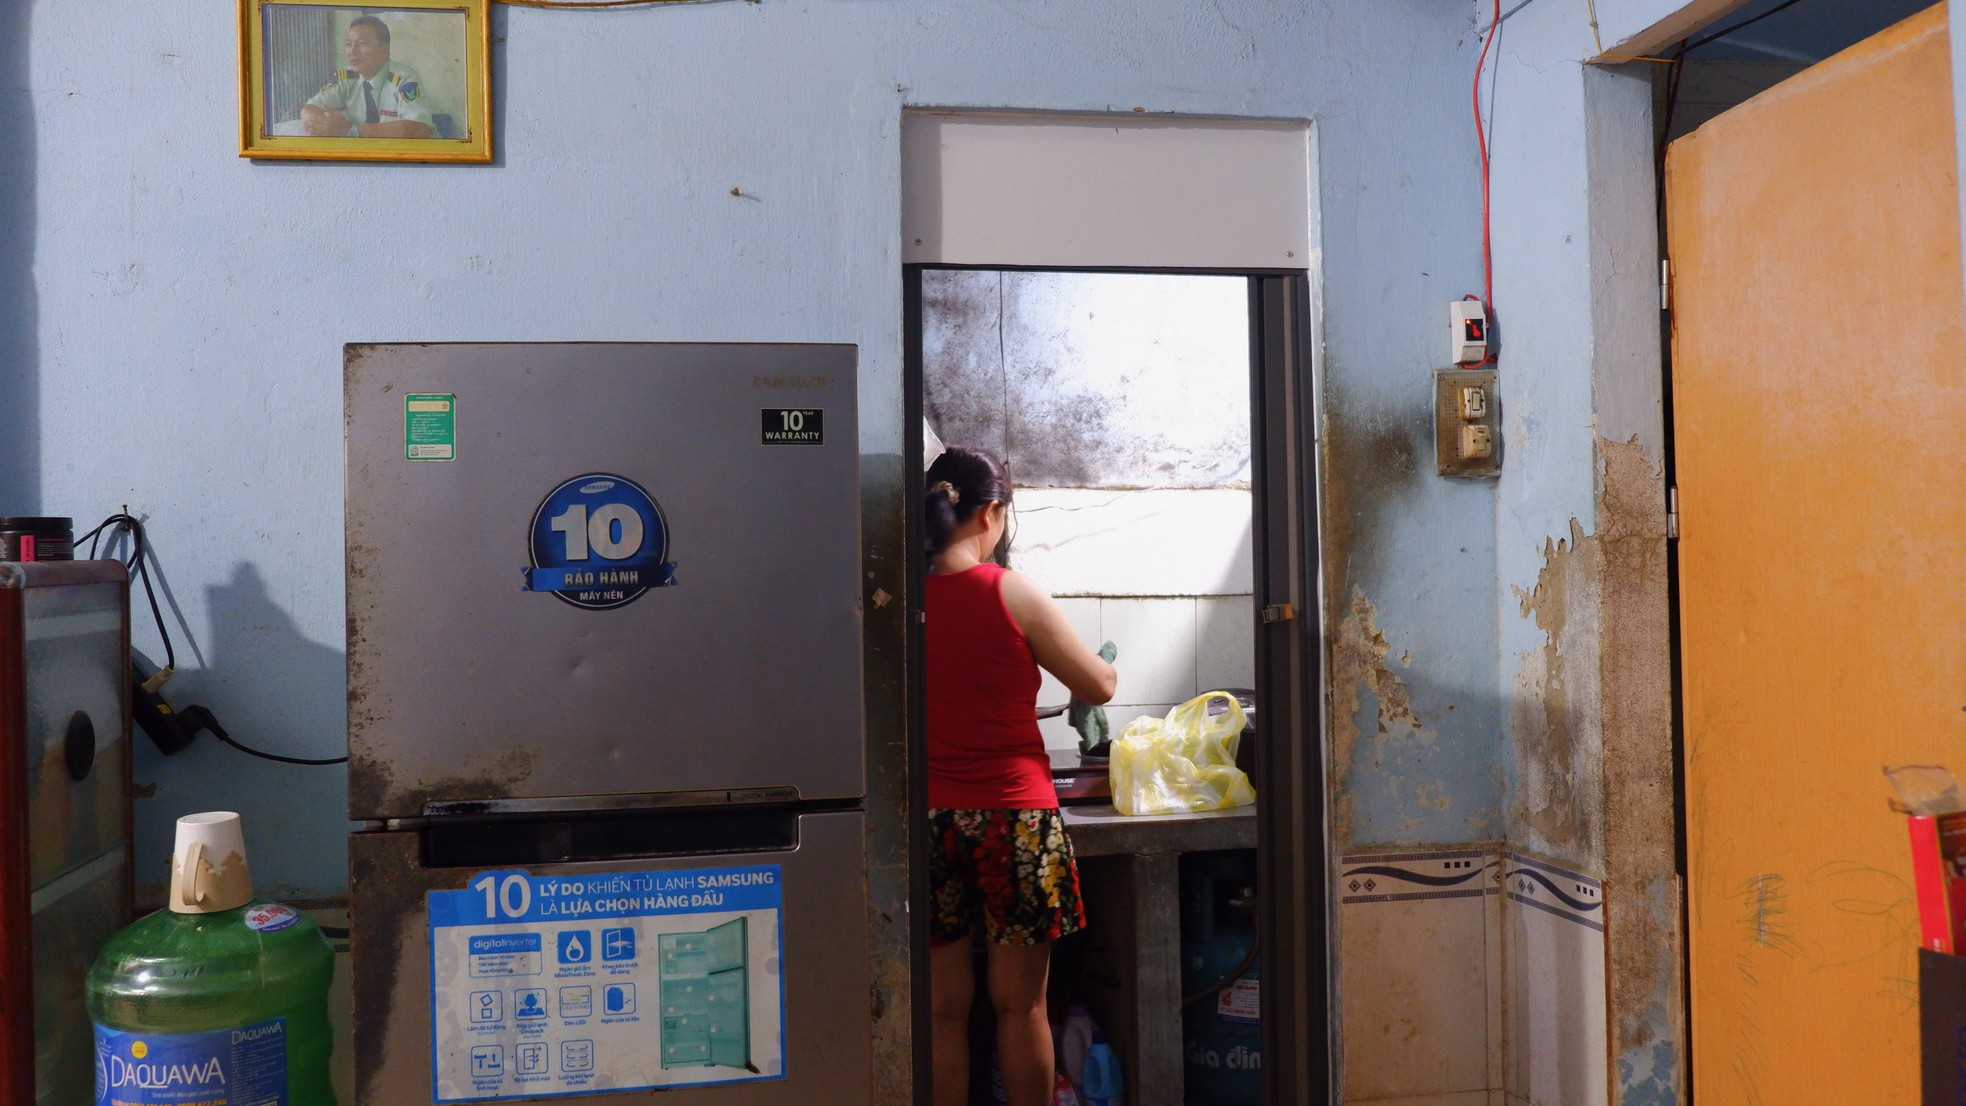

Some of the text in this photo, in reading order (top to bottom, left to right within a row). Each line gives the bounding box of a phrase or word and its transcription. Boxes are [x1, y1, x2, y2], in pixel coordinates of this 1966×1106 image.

[780, 410, 804, 431] 10
[765, 432, 820, 440] WARRANTY
[552, 503, 643, 560] 10
[564, 568, 639, 585] BẢO HÀNH
[580, 591, 601, 600] MÁY
[475, 872, 774, 918] 10 LÝ DO KHIẾN TỦ LẠNH SAMSUNG
[540, 890, 724, 917] LÀ LỰA CHỌN HÀNG ĐẦU
[232, 1022, 282, 1045] DAQUAWA
[1226, 1045, 1261, 1069] đìn
[111, 1057, 226, 1088] DAQUAWA
